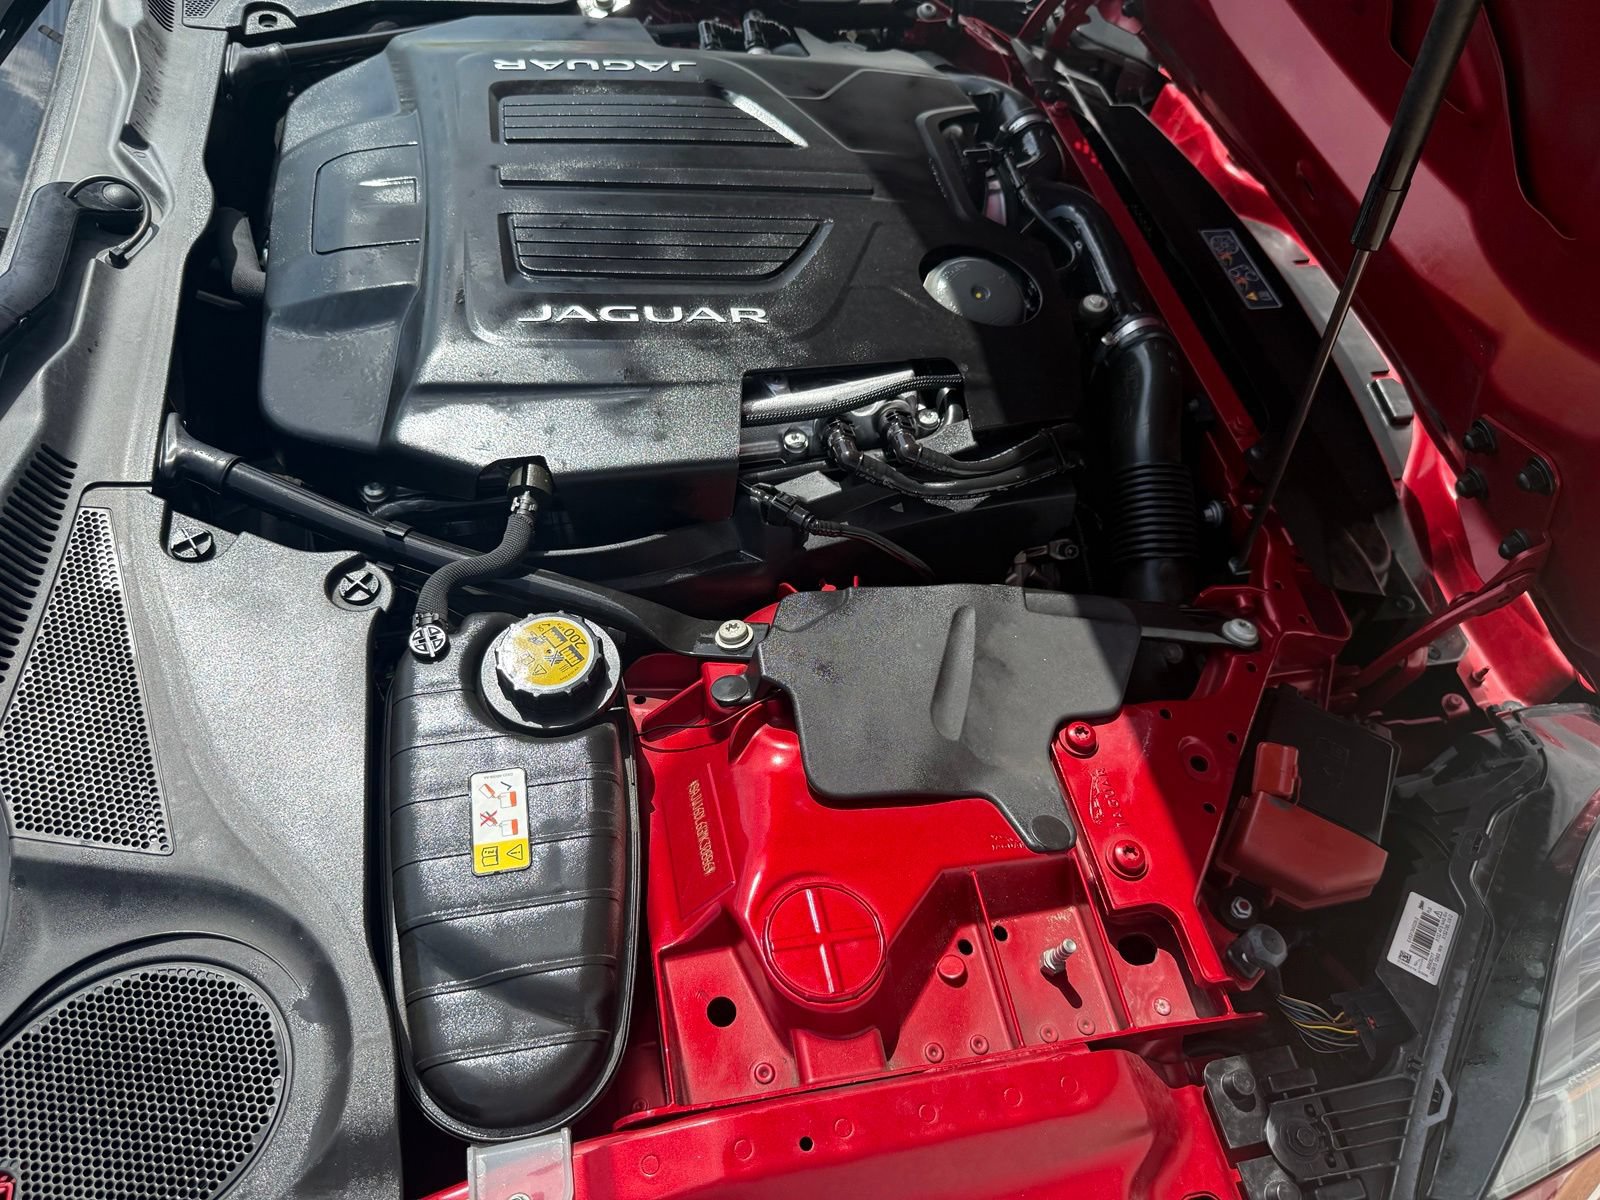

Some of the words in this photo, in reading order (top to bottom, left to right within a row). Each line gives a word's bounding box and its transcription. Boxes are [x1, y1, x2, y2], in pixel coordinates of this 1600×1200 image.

[493, 58, 697, 72] JAGUAR
[518, 304, 768, 324] JAGUAR
[563, 629, 587, 649] 200
[1095, 767, 1127, 829] JAGUAR
